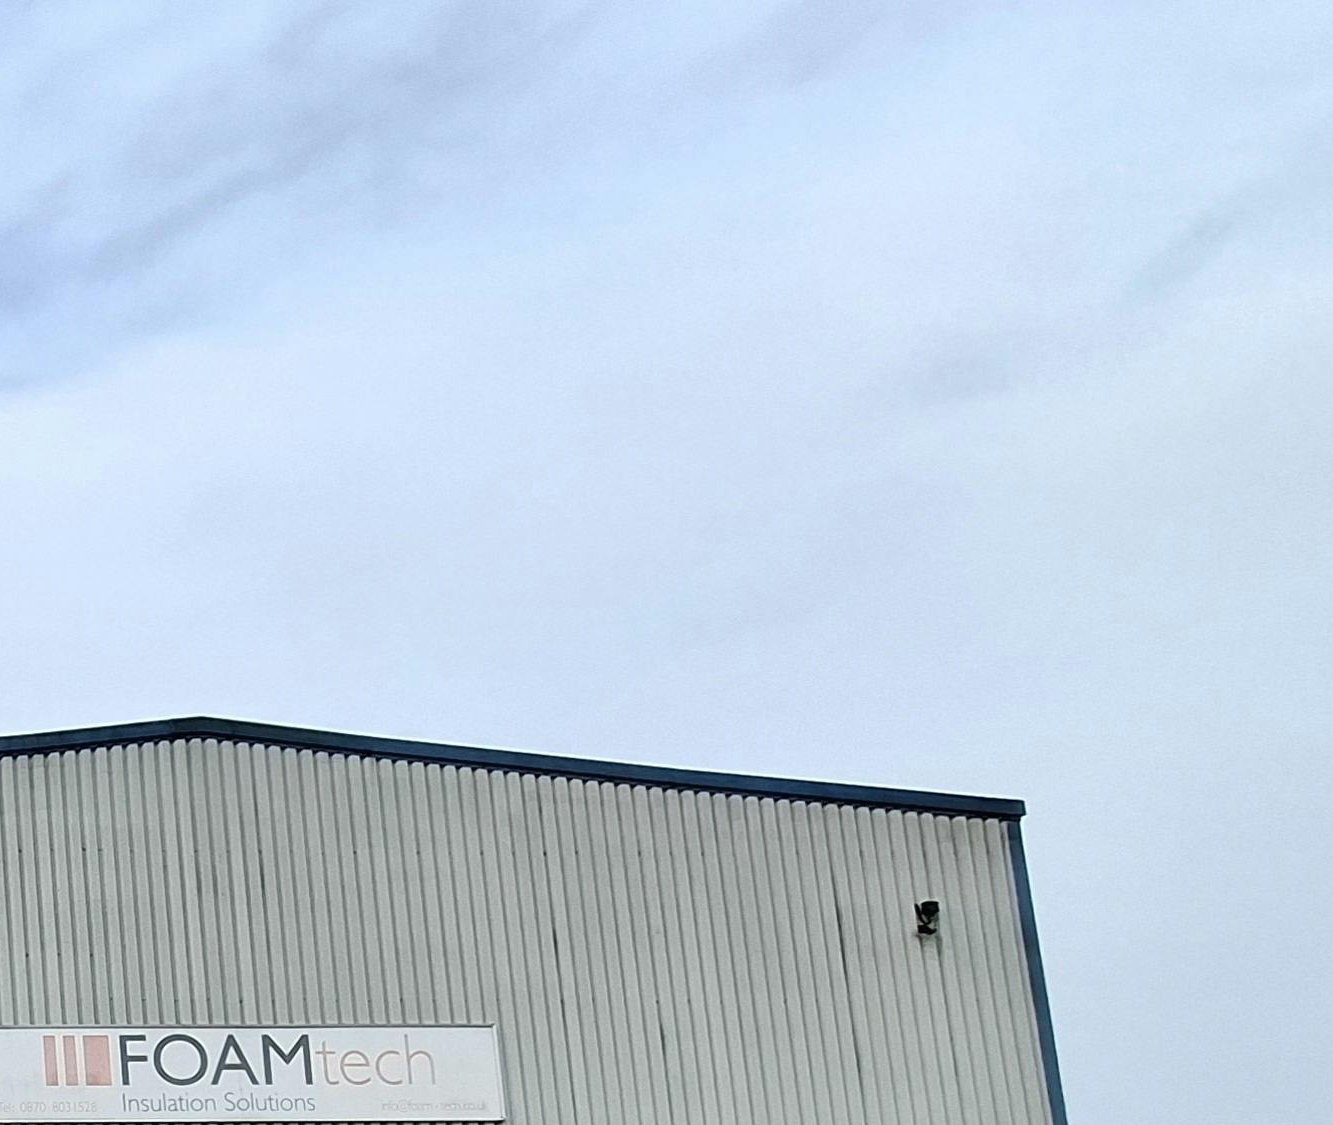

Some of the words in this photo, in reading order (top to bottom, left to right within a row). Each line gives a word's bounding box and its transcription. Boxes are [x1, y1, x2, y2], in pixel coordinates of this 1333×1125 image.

[118, 1033, 435, 1086] FOAMtech
[121, 1091, 220, 1113] Insulation
[224, 1091, 317, 1113] Solutions
